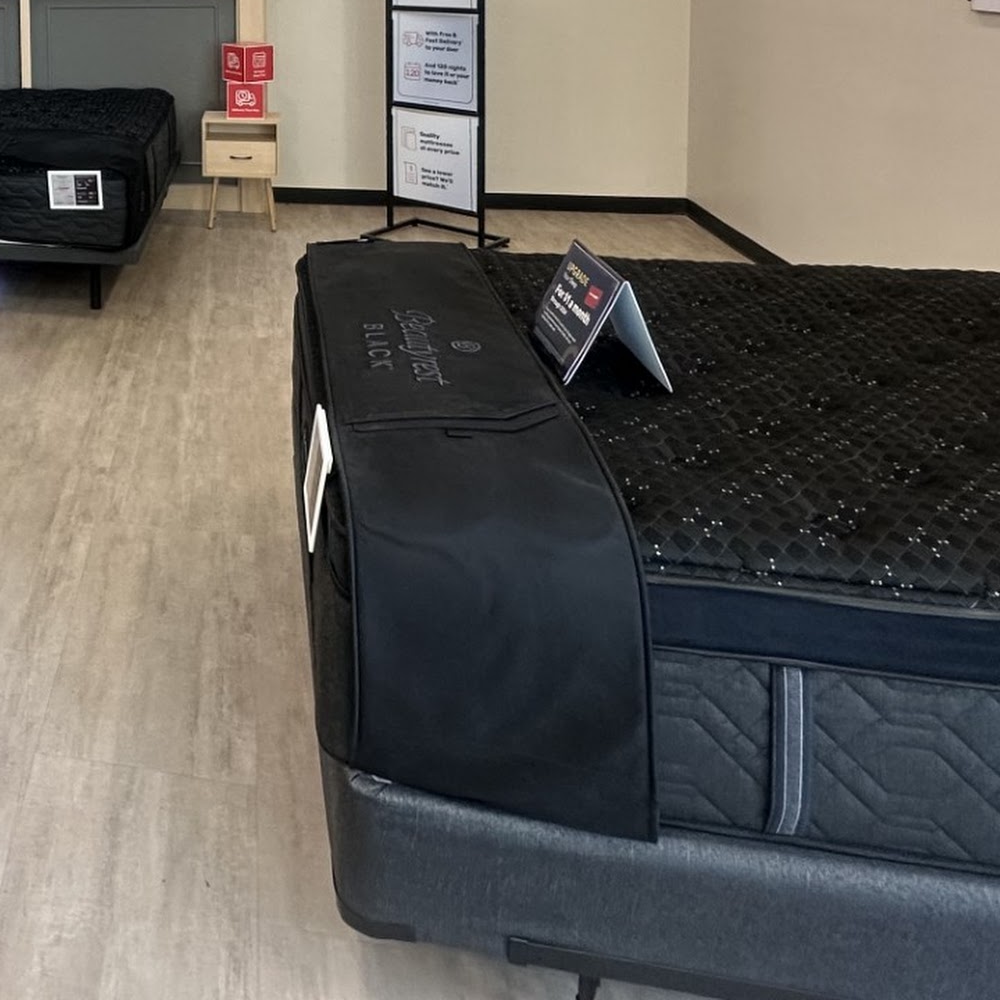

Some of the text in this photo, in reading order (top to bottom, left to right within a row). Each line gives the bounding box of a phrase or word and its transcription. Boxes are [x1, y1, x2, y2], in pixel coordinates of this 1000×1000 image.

[439, 38, 461, 46] Delivery
[420, 131, 440, 140] Quality
[555, 283, 565, 299] For
[572, 303, 591, 326] month
[363, 323, 393, 370] BLACK
[391, 308, 452, 386] Beautyrest
